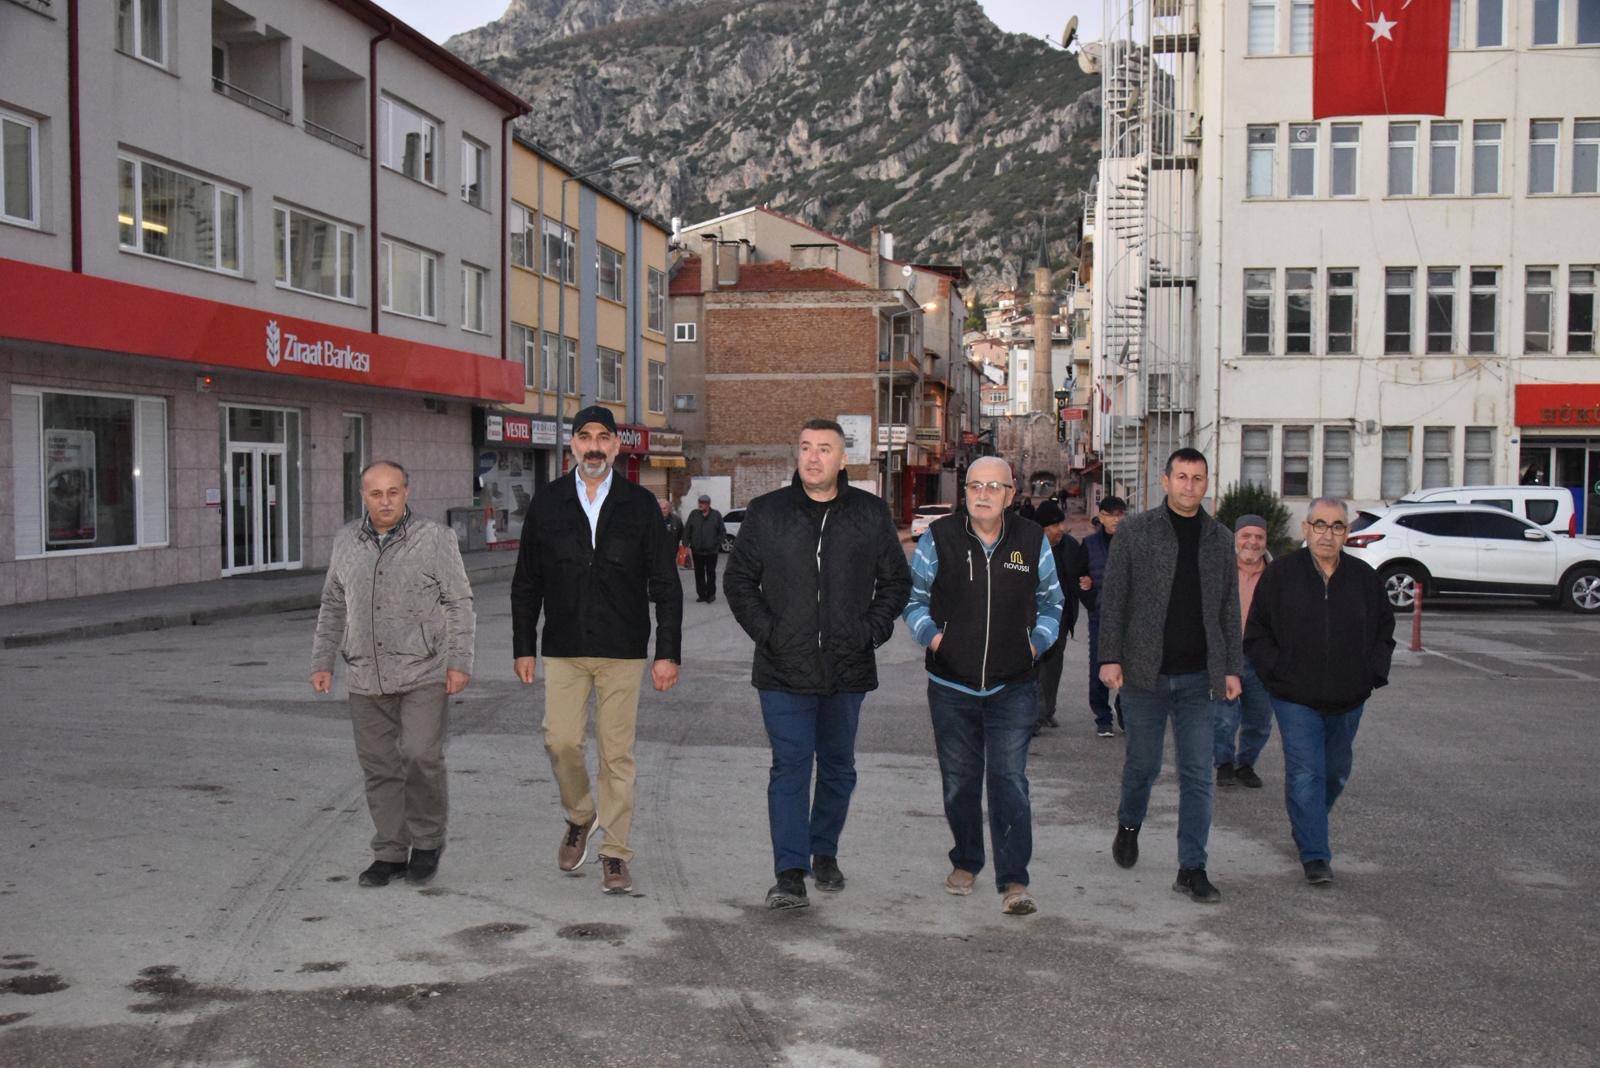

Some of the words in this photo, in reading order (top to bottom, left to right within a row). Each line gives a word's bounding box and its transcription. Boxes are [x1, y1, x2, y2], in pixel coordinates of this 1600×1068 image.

[283, 333, 323, 365] Ziraat
[324, 340, 370, 373] Bankası
[505, 421, 530, 439] VESTEL
